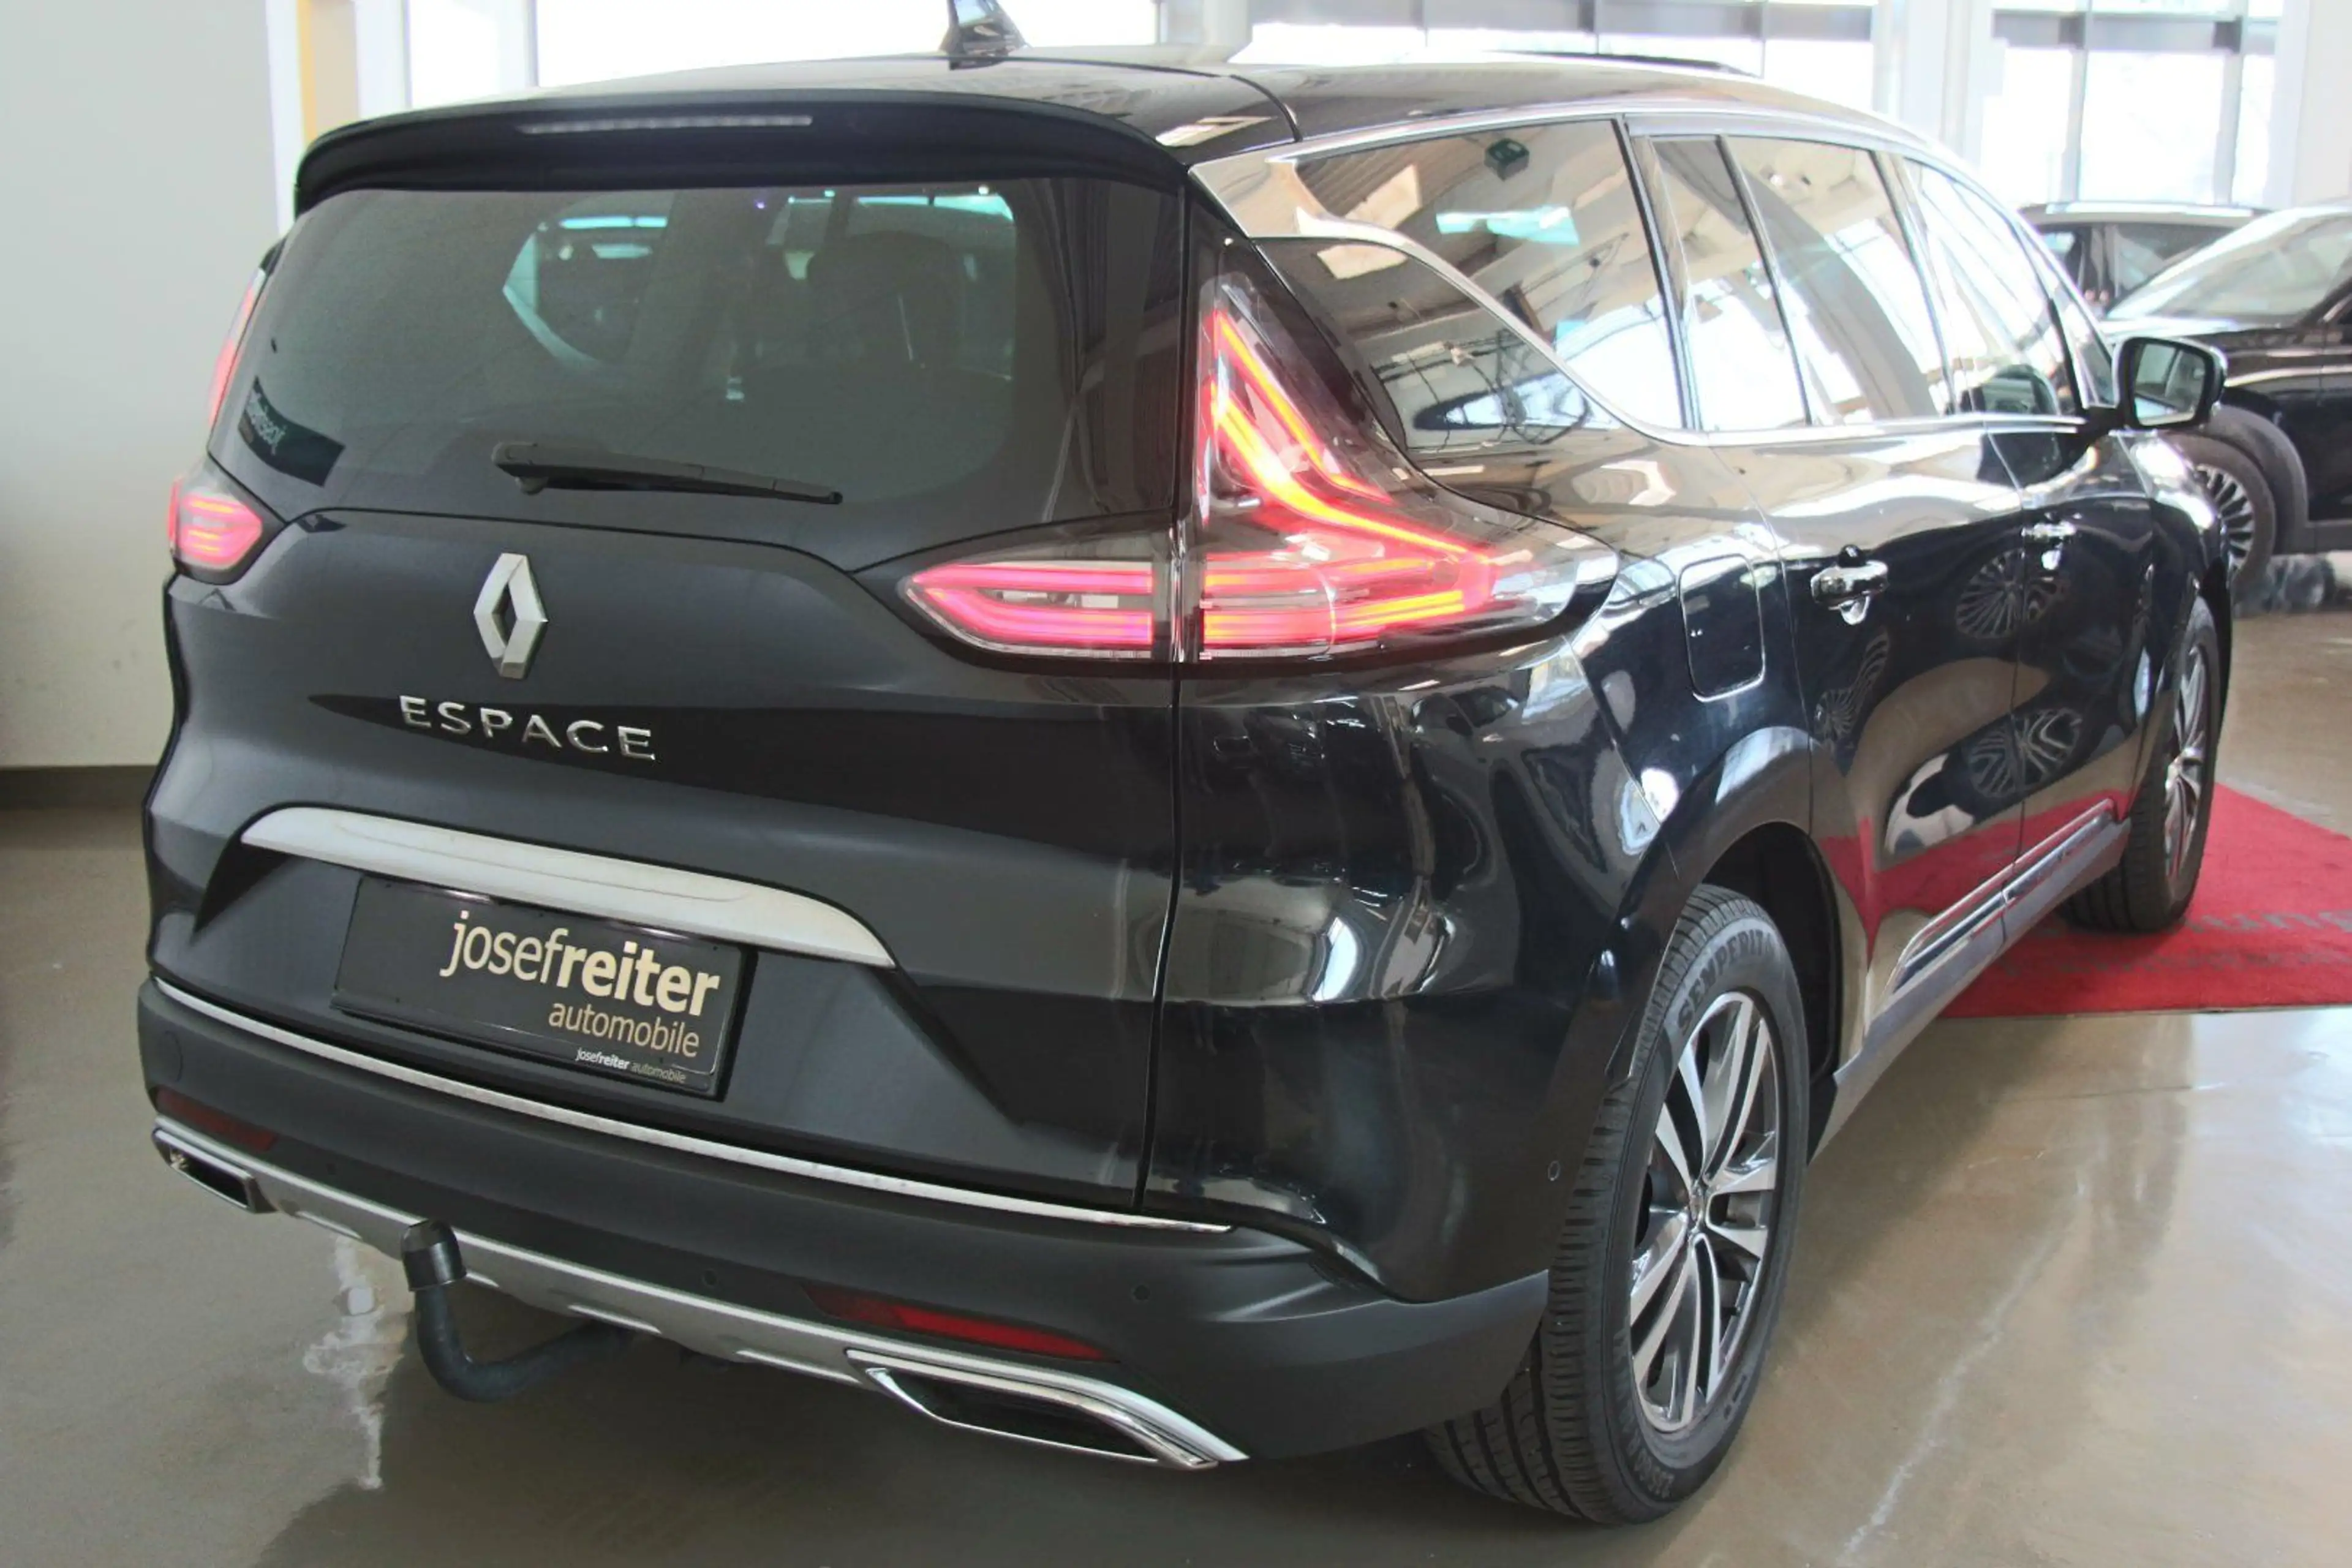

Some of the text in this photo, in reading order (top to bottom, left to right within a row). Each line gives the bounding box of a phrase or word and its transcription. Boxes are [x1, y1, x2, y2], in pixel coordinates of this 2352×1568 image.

[399, 695, 656, 760] ESPACE
[439, 910, 721, 1016] josefreiter
[1678, 929, 1764, 1036] SEMPERIT
[549, 1002, 699, 1058] automobile
[575, 1047, 687, 1084] josefreiter automobile
